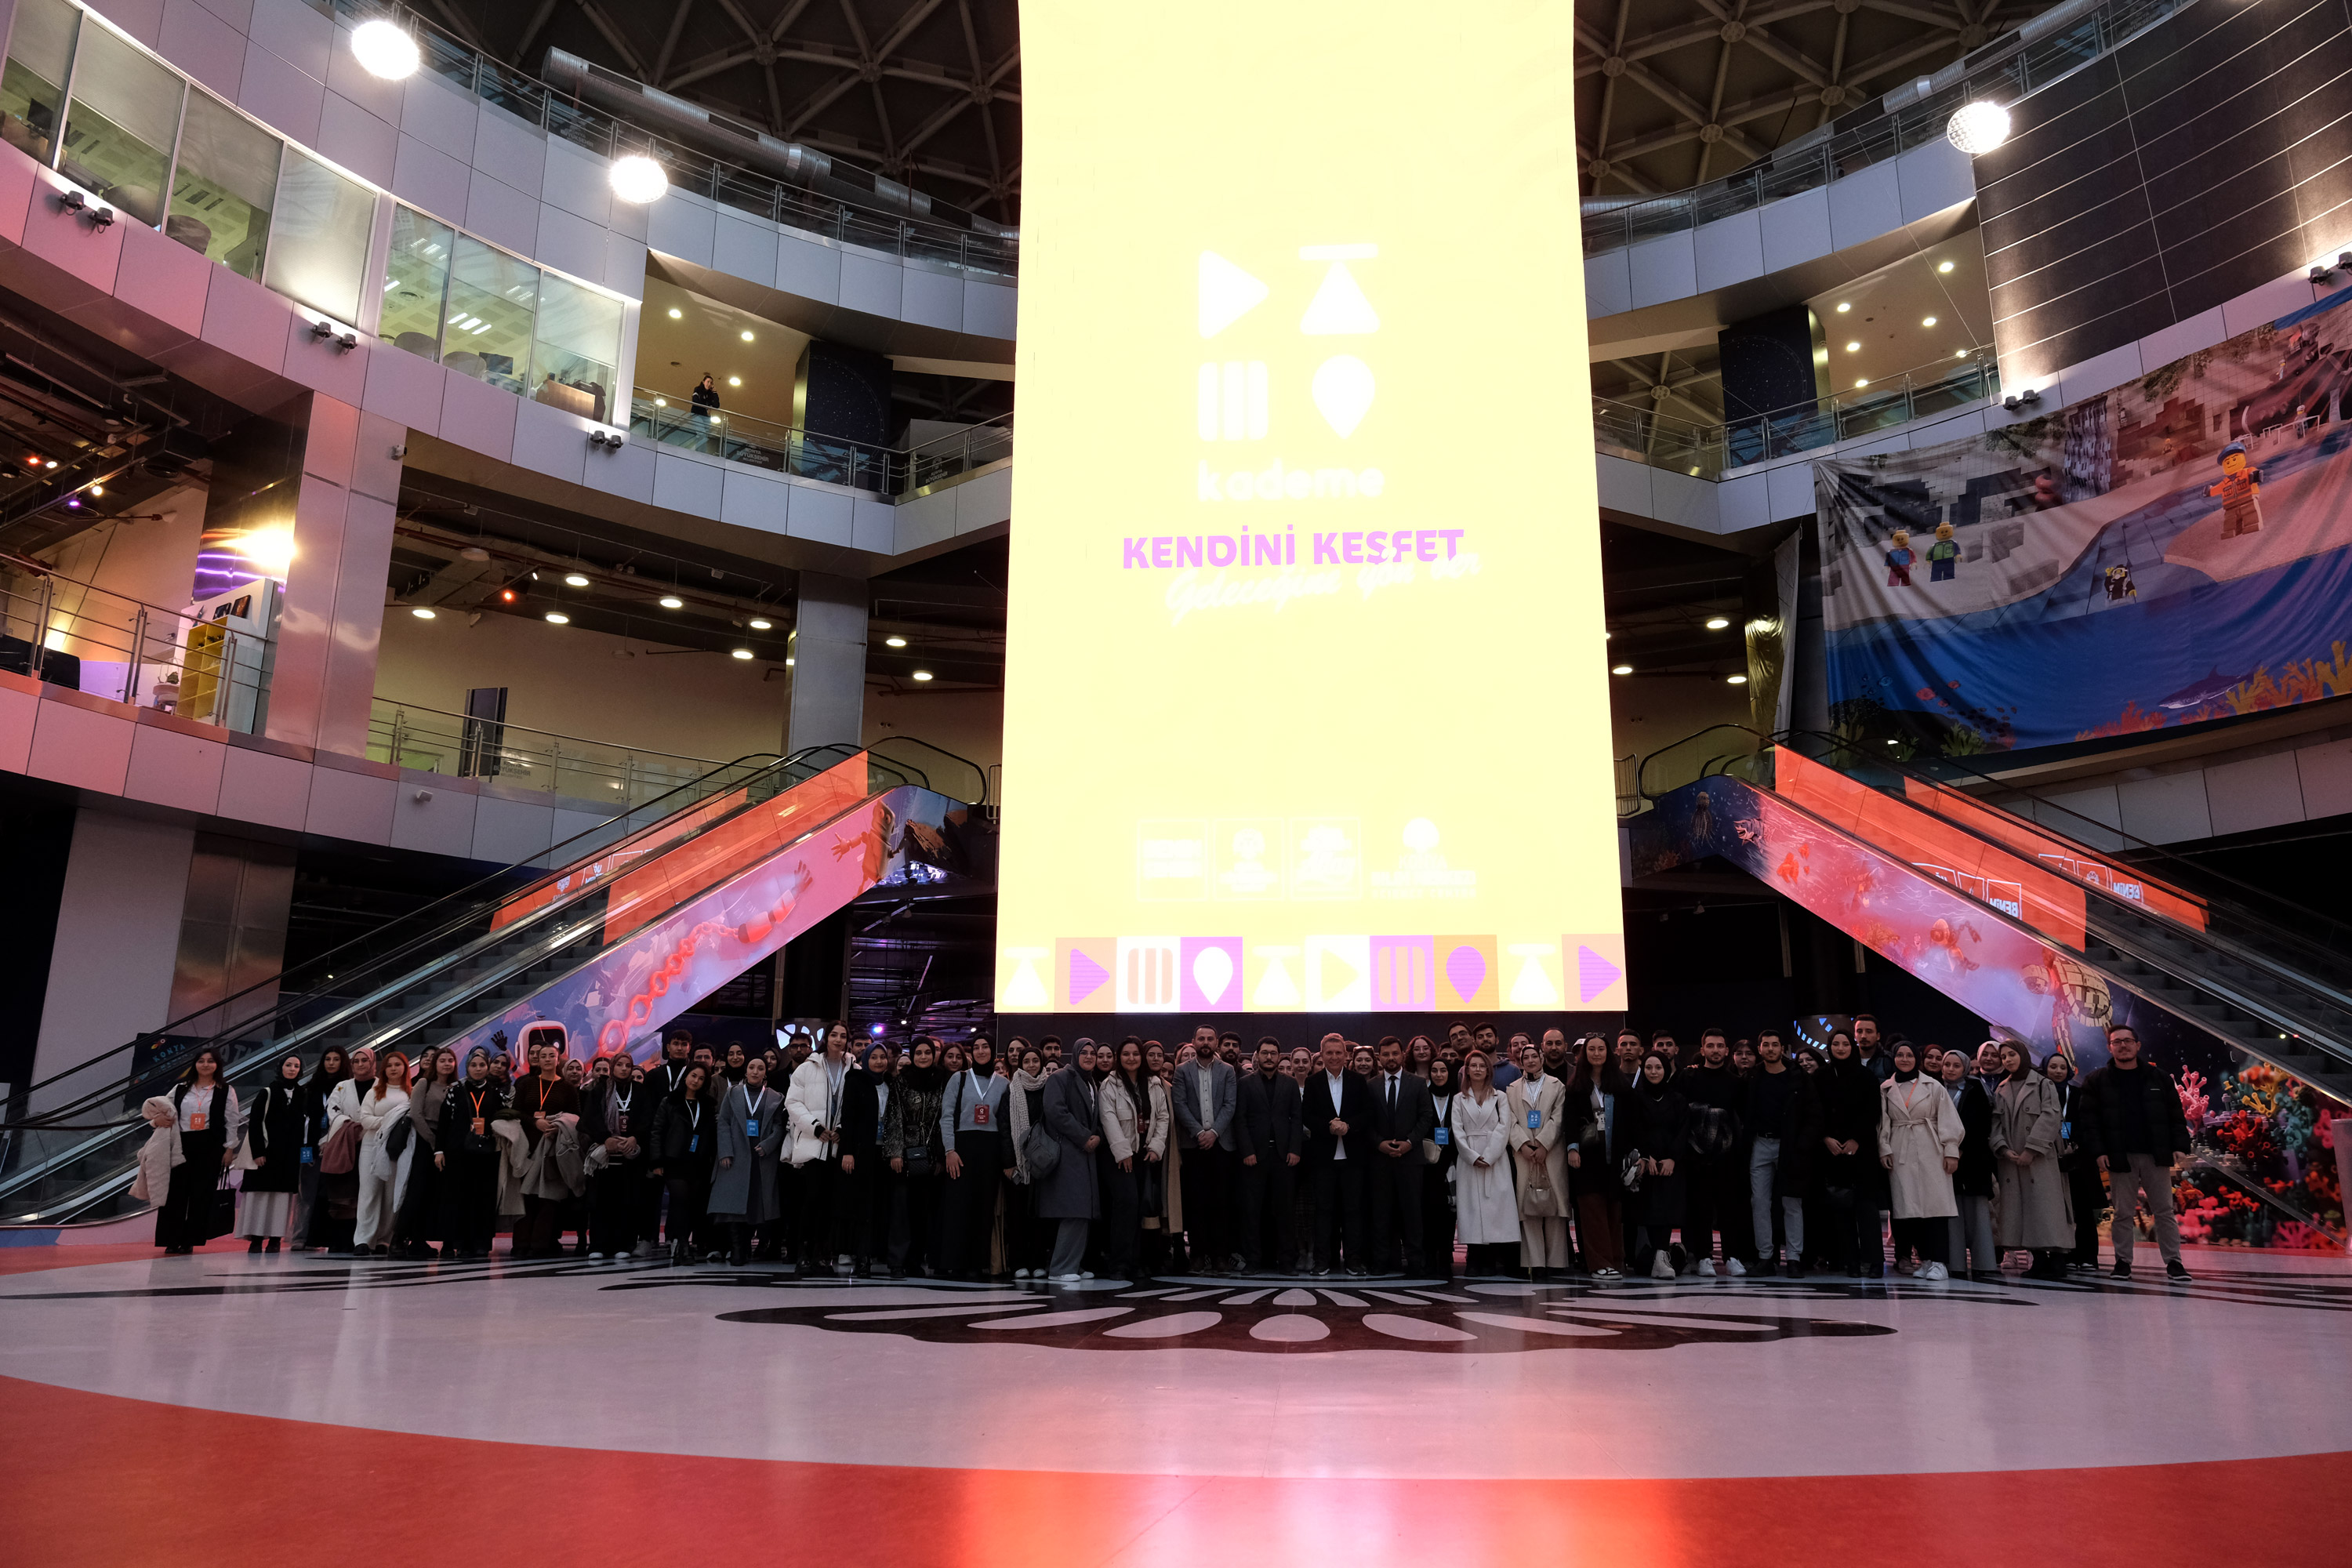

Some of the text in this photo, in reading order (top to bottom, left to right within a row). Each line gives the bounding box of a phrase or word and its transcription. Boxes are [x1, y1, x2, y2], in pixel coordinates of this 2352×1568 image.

[1197, 458, 1385, 502] kademe
[1123, 524, 1295, 569] KENDİNİ
[152, 1043, 187, 1063] KONYA
